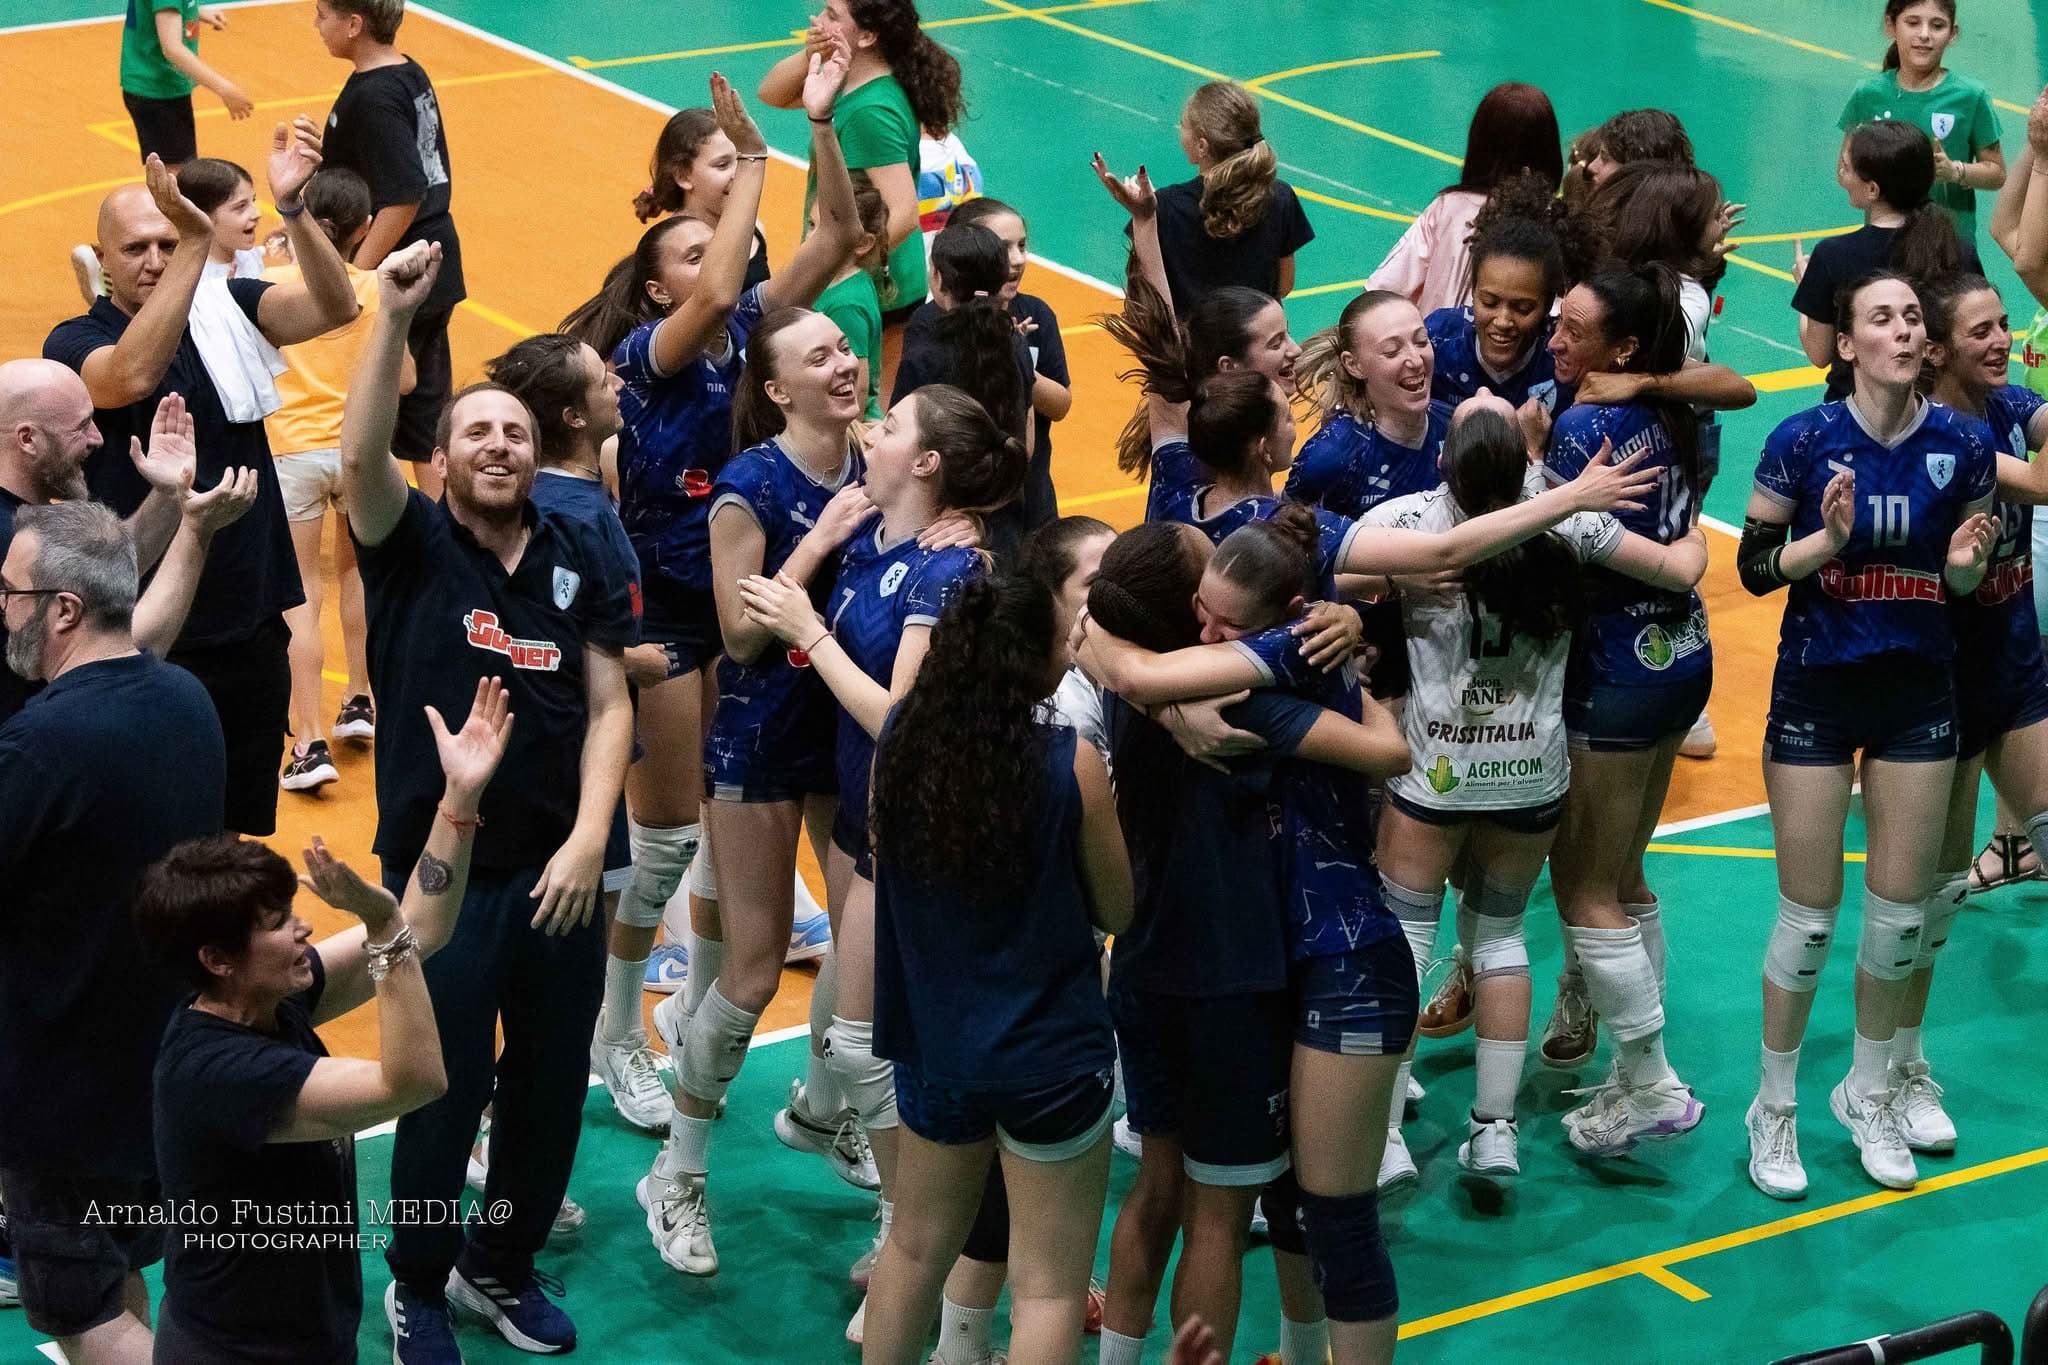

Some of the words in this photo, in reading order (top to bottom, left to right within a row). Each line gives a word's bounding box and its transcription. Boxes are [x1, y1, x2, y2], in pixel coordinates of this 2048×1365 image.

[1867, 495, 1910, 548] 10
[1461, 688, 1505, 706] PANE
[1427, 721, 1536, 744] GRISSITALIA
[1467, 757, 1543, 779] AGRICOM
[1465, 780, 1496, 788] Alimenti
